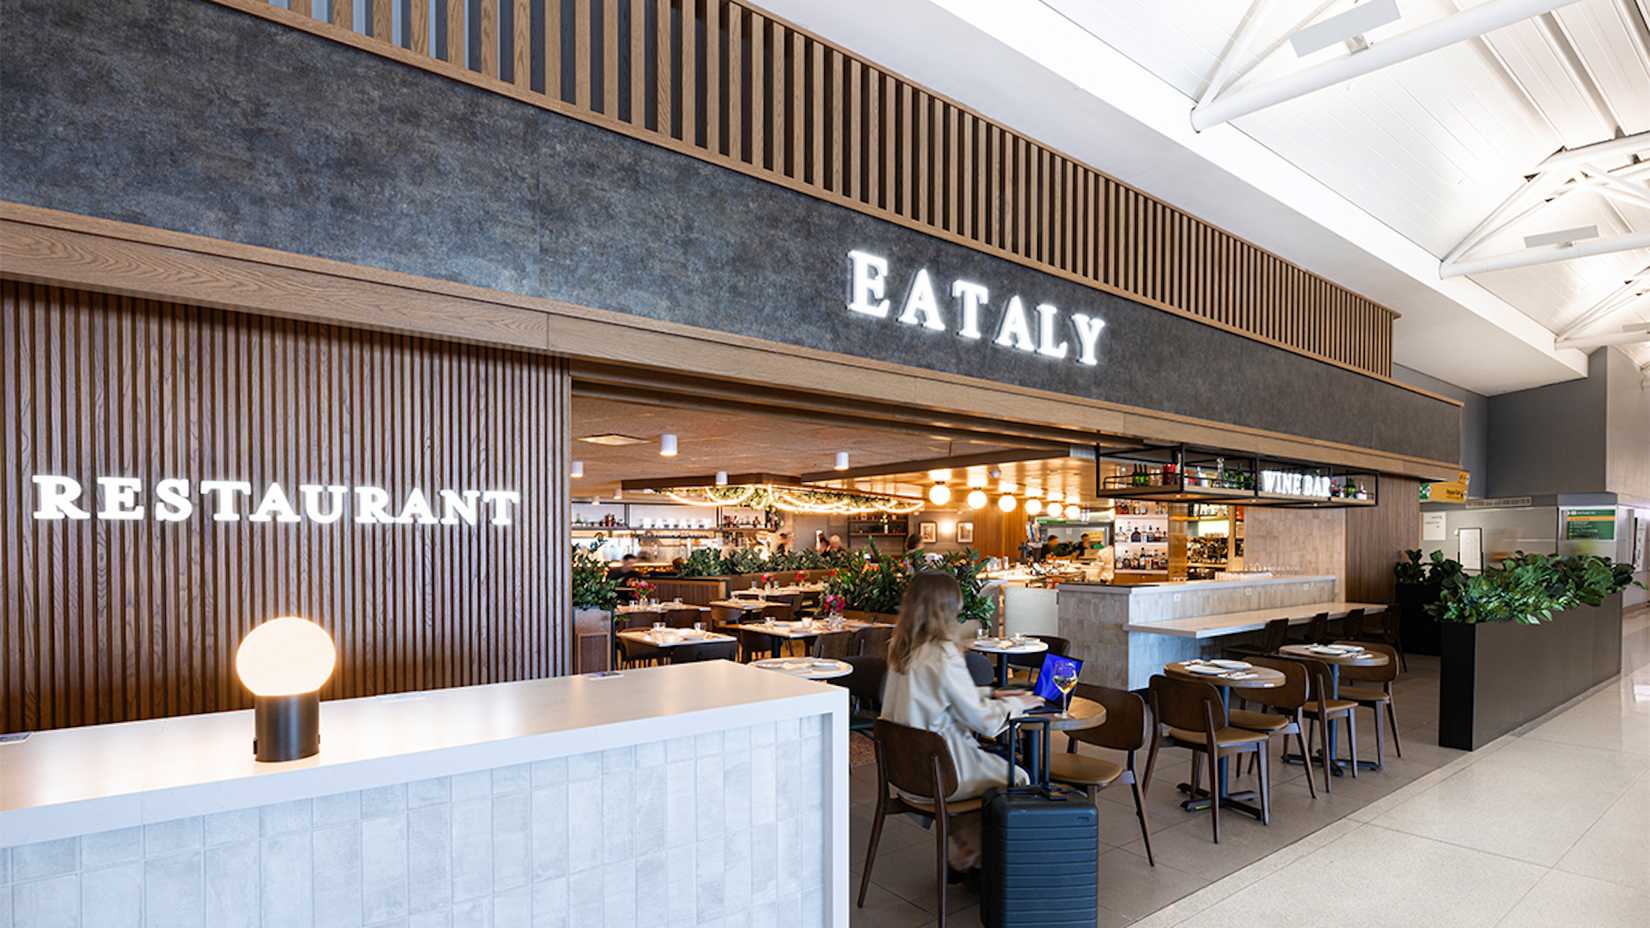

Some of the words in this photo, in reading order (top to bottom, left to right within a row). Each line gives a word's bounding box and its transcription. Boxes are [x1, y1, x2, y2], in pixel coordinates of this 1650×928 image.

[847, 250, 1105, 366] EATALY
[32, 475, 520, 526] RESTAURANT
[1260, 470, 1301, 495] WINE
[1302, 474, 1331, 497] BAR
